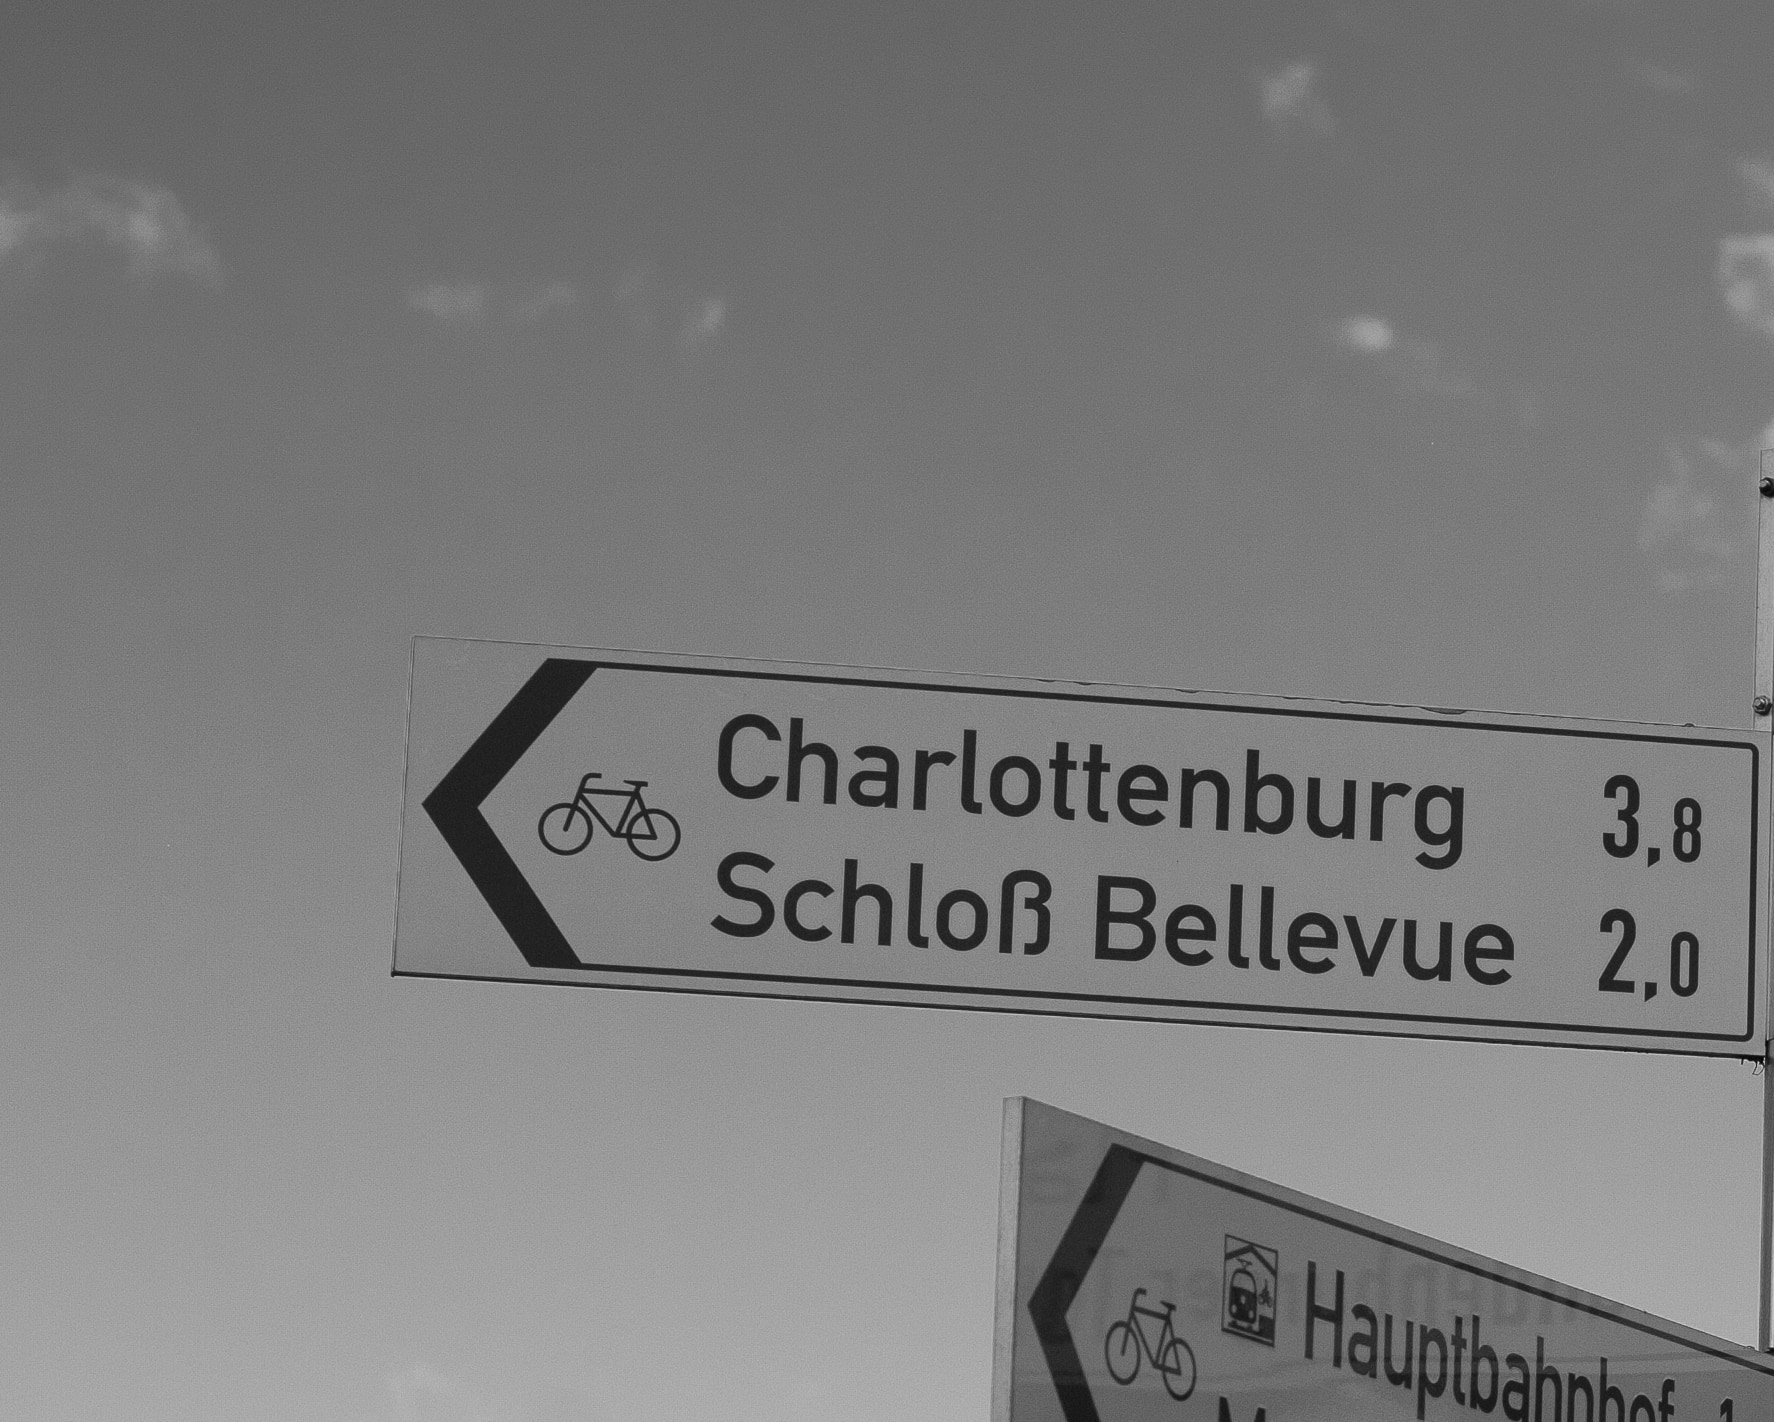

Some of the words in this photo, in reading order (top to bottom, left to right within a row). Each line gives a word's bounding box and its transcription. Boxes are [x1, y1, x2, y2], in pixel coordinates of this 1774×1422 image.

[717, 713, 1465, 871] Charlottenburg
[1602, 774, 1702, 868] 3,8
[710, 851, 1053, 956] Schloß
[1094, 874, 1515, 986] Bellevue
[1598, 908, 1700, 1003] 2,0
